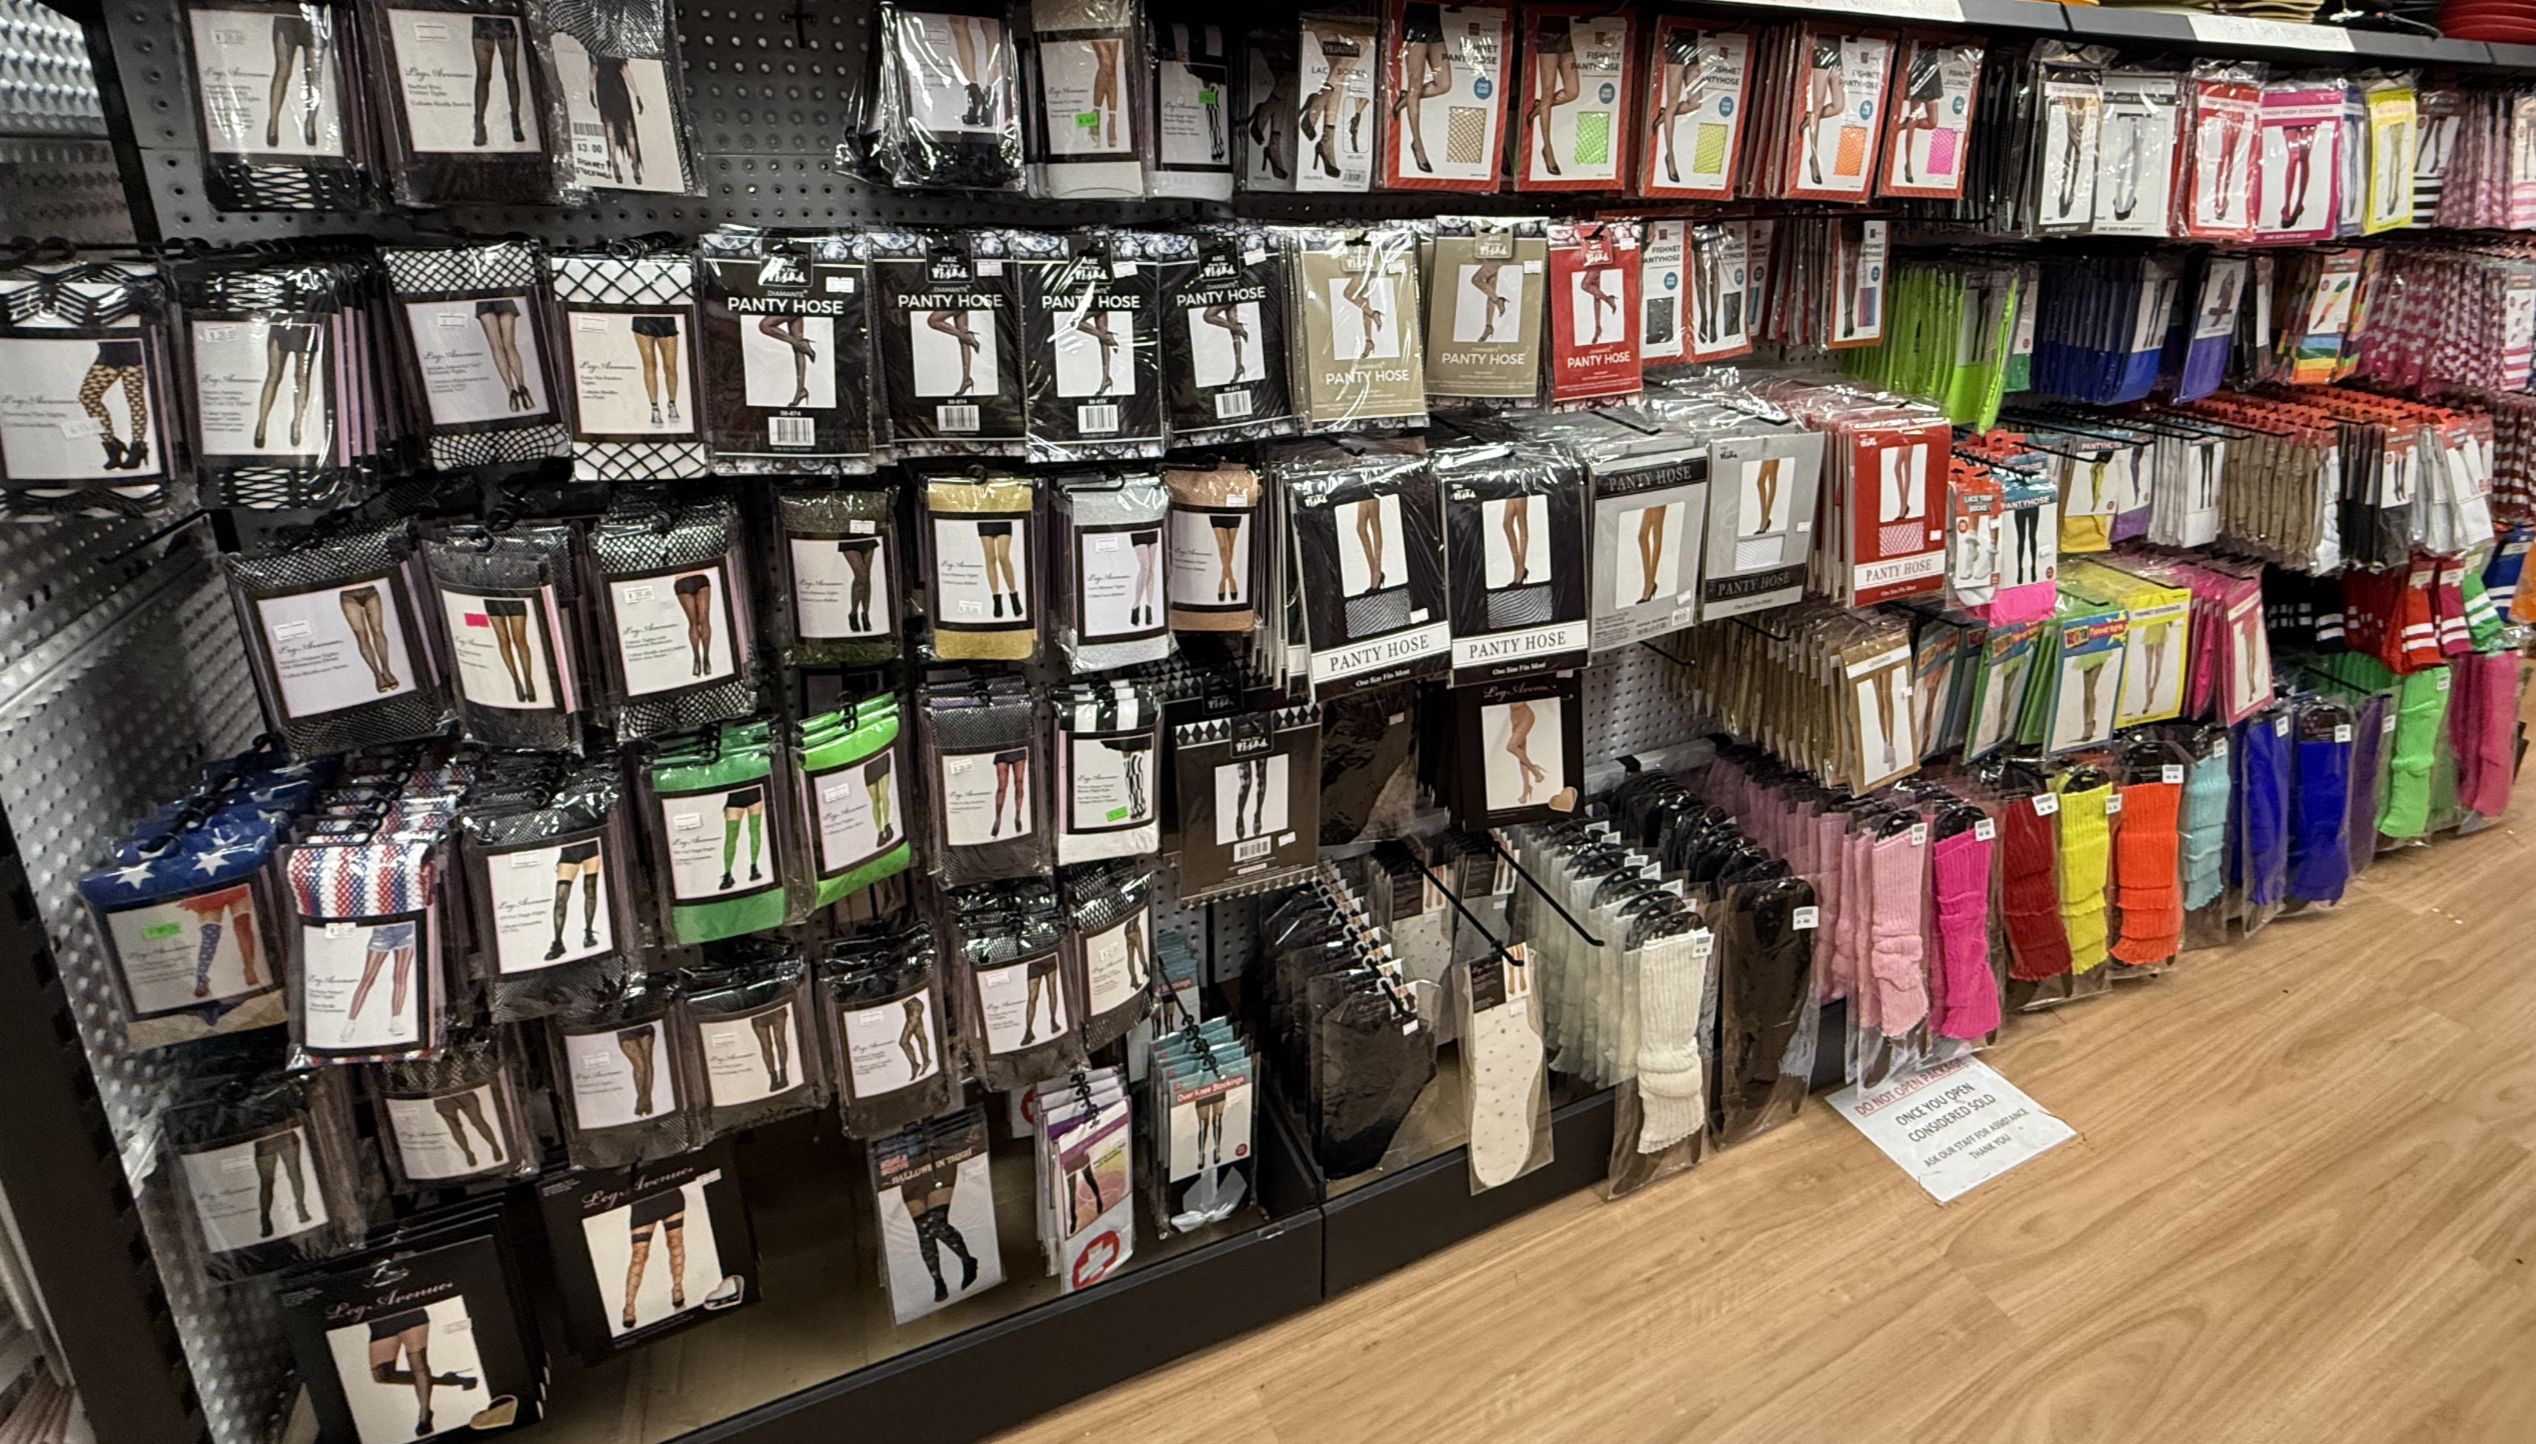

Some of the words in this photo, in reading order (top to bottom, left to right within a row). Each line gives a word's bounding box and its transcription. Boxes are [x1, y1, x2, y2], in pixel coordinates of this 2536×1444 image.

[728, 296, 788, 314] PANTY
[793, 299, 844, 315] HOSE
[899, 294, 962, 308] PANTY
[966, 294, 1004, 308] HOSE
[1098, 295, 1140, 308] HOSE
[1177, 290, 1224, 306] PANTY
[1226, 286, 1266, 302] HOSE
[1442, 353, 1486, 366] PANTY
[1490, 353, 1525, 366] HOSE
[1567, 355, 1602, 368] PANTY
[1604, 351, 1630, 364] HOSE
[1326, 370, 1370, 385] PANTY
[1375, 369, 1410, 382] HOSE
[1608, 472, 1652, 492] PANTY
[1656, 465, 1692, 484] HOSE
[1865, 564, 1902, 582] PANTY
[1904, 558, 1932, 576] HOSE
[1718, 580, 1757, 597] PANTY
[1760, 572, 1790, 589] HOSE
[1330, 646, 1382, 672] PANTY
[1387, 634, 1430, 658] HOSE
[1469, 638, 1520, 659] PANTY
[1522, 632, 1566, 650] HOSE
[1854, 1100, 1874, 1116] DO
[1874, 1091, 1894, 1109] NOT
[1894, 1078, 1924, 1098] OPEN
[1895, 1105, 1926, 1127] ONCE
[1924, 1094, 1948, 1114] YOU
[1944, 1082, 1976, 1102] OPEN
[1908, 1104, 1972, 1143] CONSIDERED
[1972, 1092, 1996, 1112] SOLD
[1924, 1152, 1940, 1168] ASK
[1939, 1144, 1956, 1161] OUR
[1955, 1135, 1976, 1152] STAFF
[1975, 1128, 1990, 1142] FOR
[1989, 1107, 2030, 1134] ASSISTANCE
[1968, 1142, 1996, 1160] THANK
[1994, 1134, 2012, 1148] YOU
[581, 1190, 619, 1210] Leg
[634, 1166, 691, 1191] Avenue
[326, 1302, 367, 1322] Leg
[376, 1281, 450, 1306] Avenue
